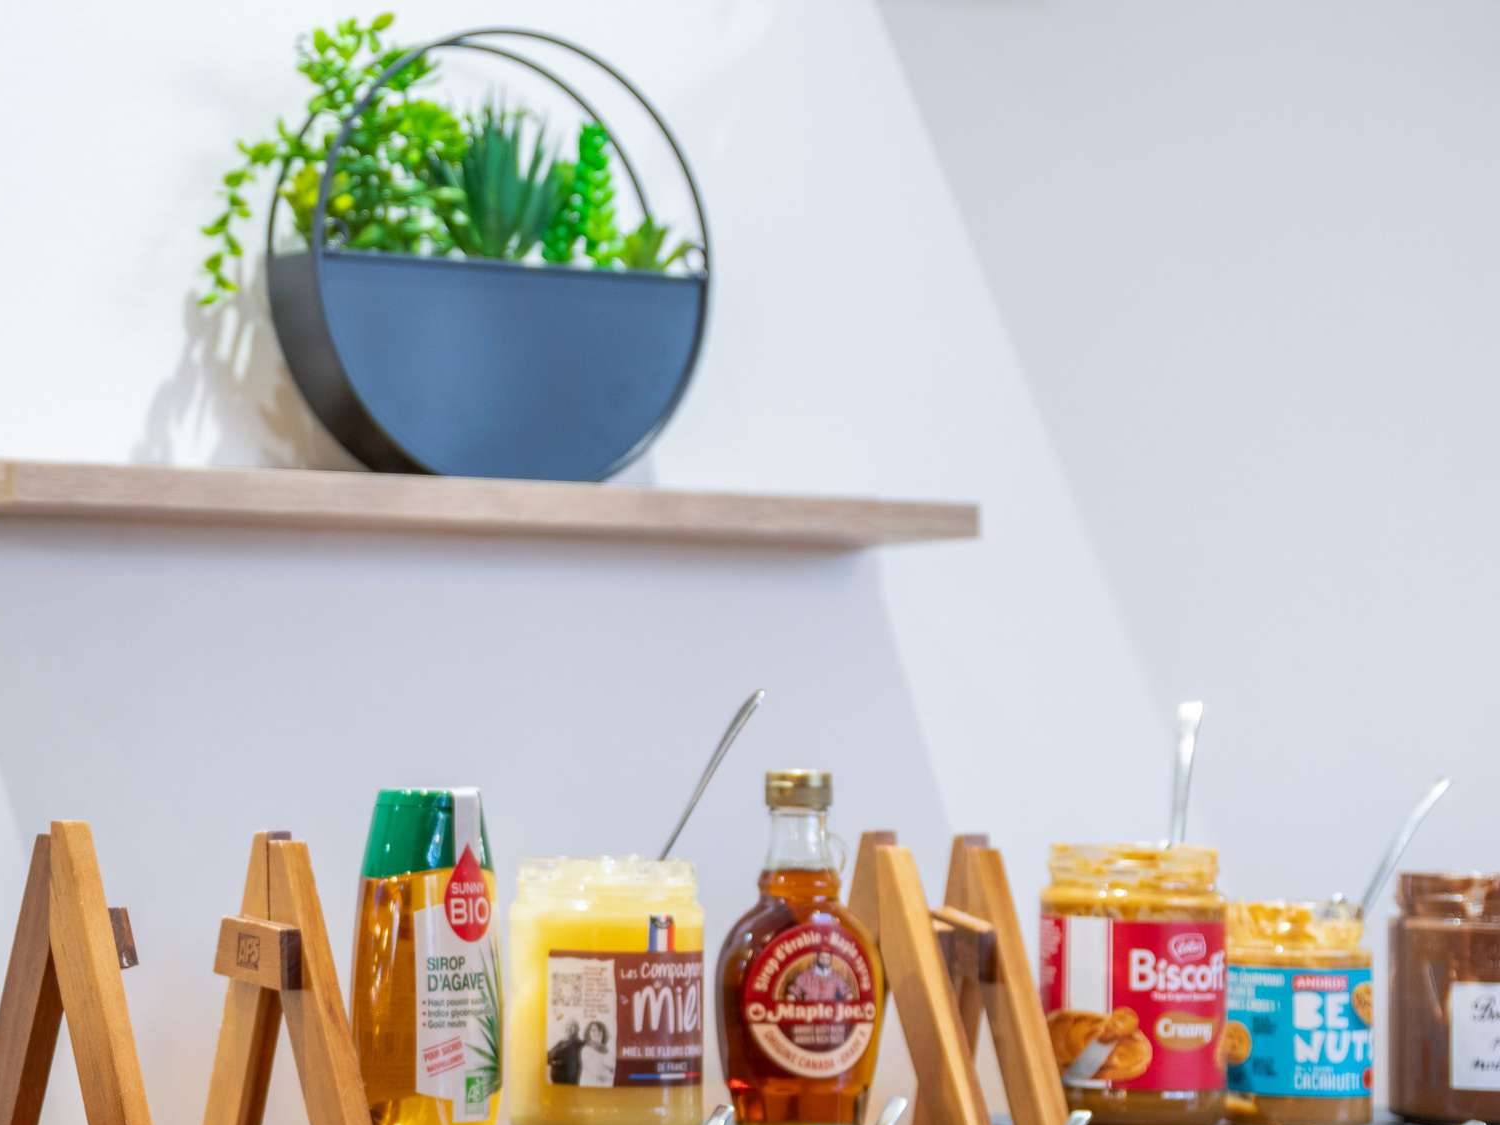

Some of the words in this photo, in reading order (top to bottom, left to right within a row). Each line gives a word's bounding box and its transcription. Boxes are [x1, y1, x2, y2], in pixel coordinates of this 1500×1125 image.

[451, 882, 484, 894] SUNNY
[450, 897, 490, 925] BIO
[427, 956, 466, 971] SIROP
[753, 957, 780, 992] Sirop
[427, 972, 485, 992] D'AGAVE
[766, 1003, 834, 1022] Maple
[1292, 991, 1350, 1030] BE
[1156, 1017, 1213, 1042] Creamy
